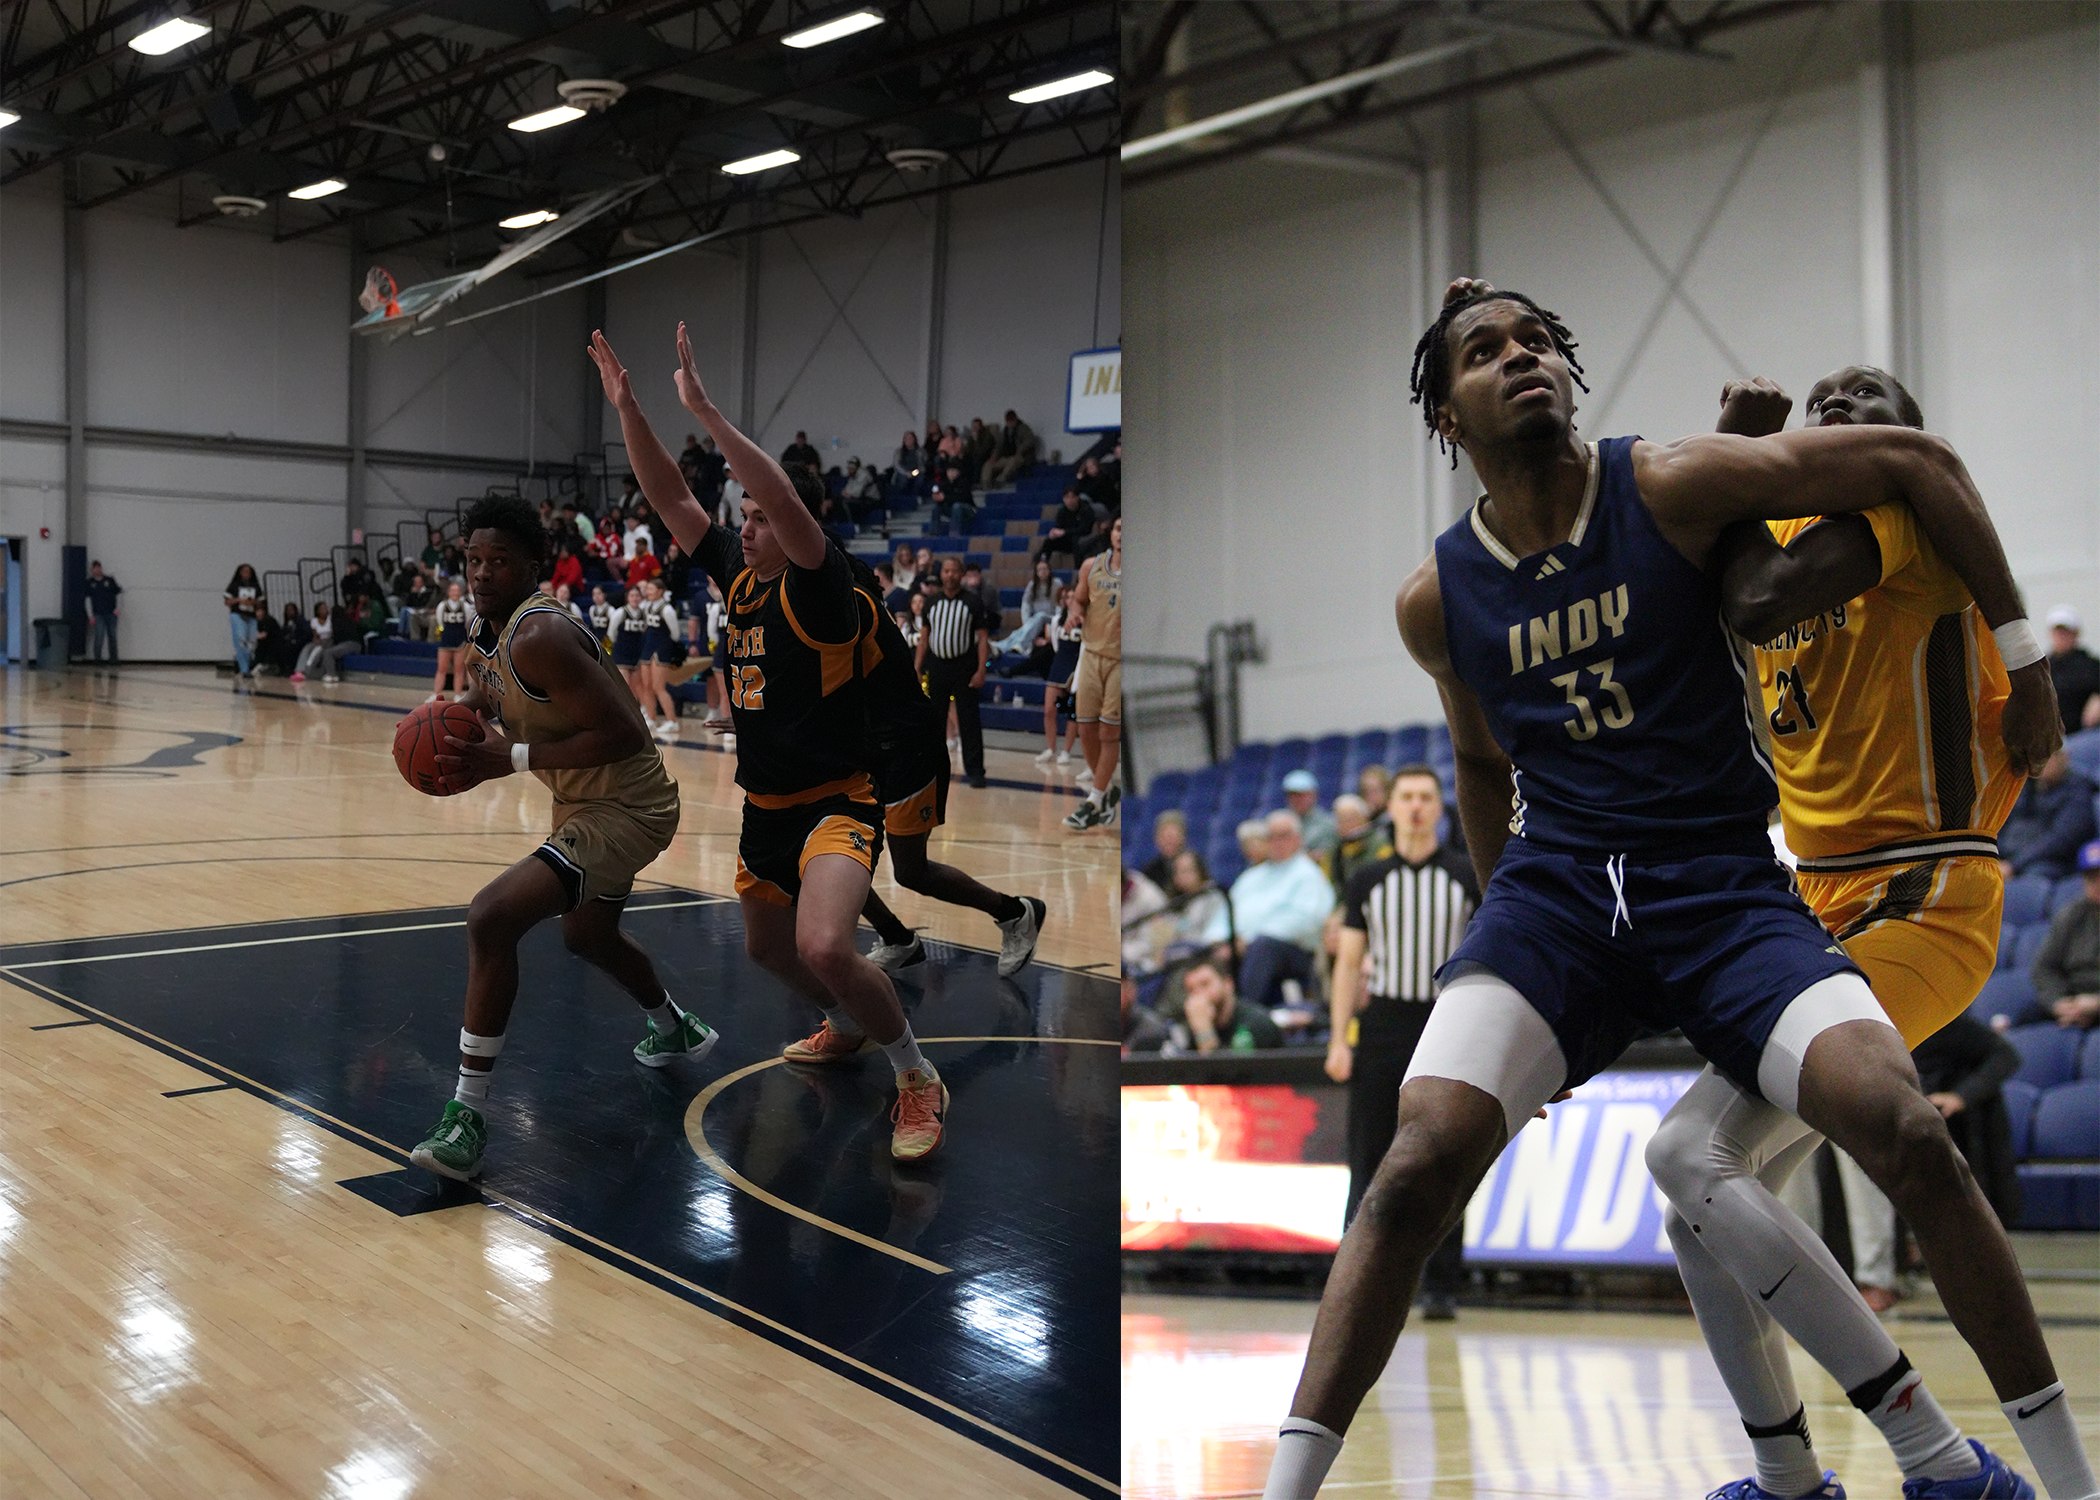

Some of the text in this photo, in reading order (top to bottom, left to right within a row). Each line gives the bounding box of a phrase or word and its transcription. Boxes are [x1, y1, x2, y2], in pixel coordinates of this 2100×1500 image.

[726, 622, 766, 659] TECH
[1509, 582, 1630, 676] INDY
[1549, 656, 1635, 741] 33
[1769, 664, 1818, 736] 21
